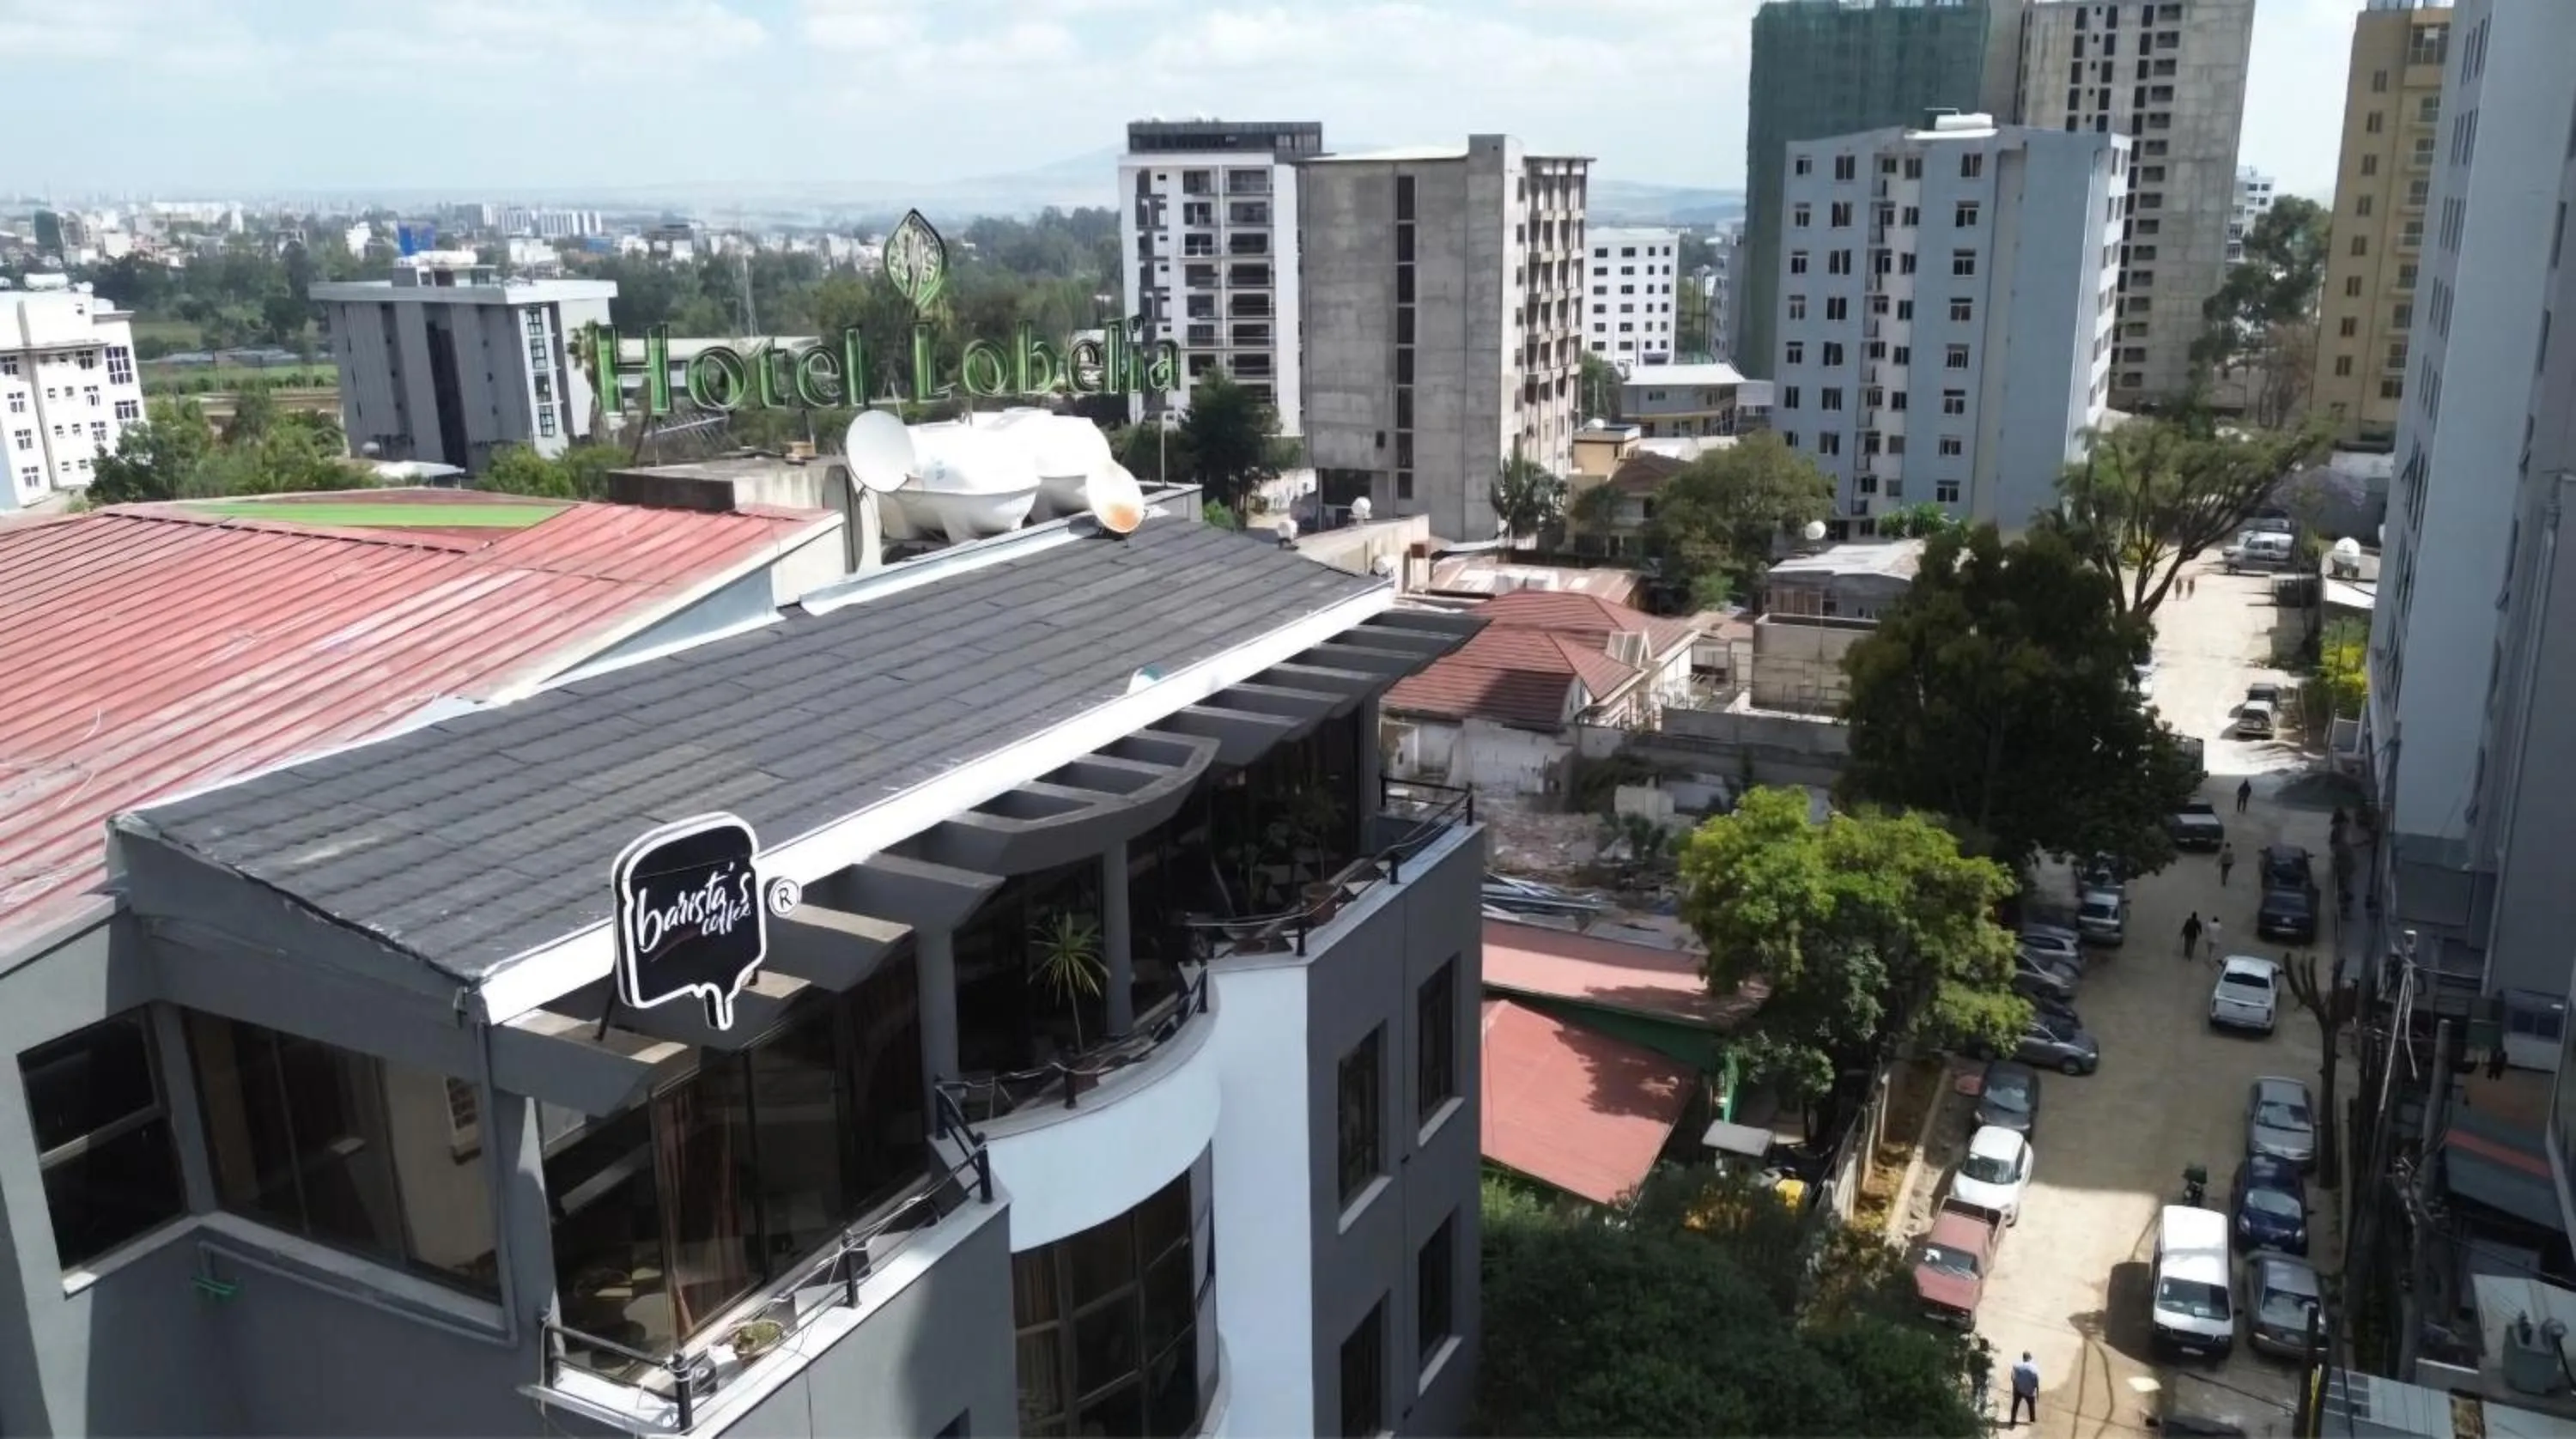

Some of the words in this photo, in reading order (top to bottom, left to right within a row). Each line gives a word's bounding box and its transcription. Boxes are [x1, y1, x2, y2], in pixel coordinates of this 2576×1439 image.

[596, 321, 868, 417] Hotel
[910, 314, 1182, 404] Lobelia
[701, 899, 753, 936] coffee
